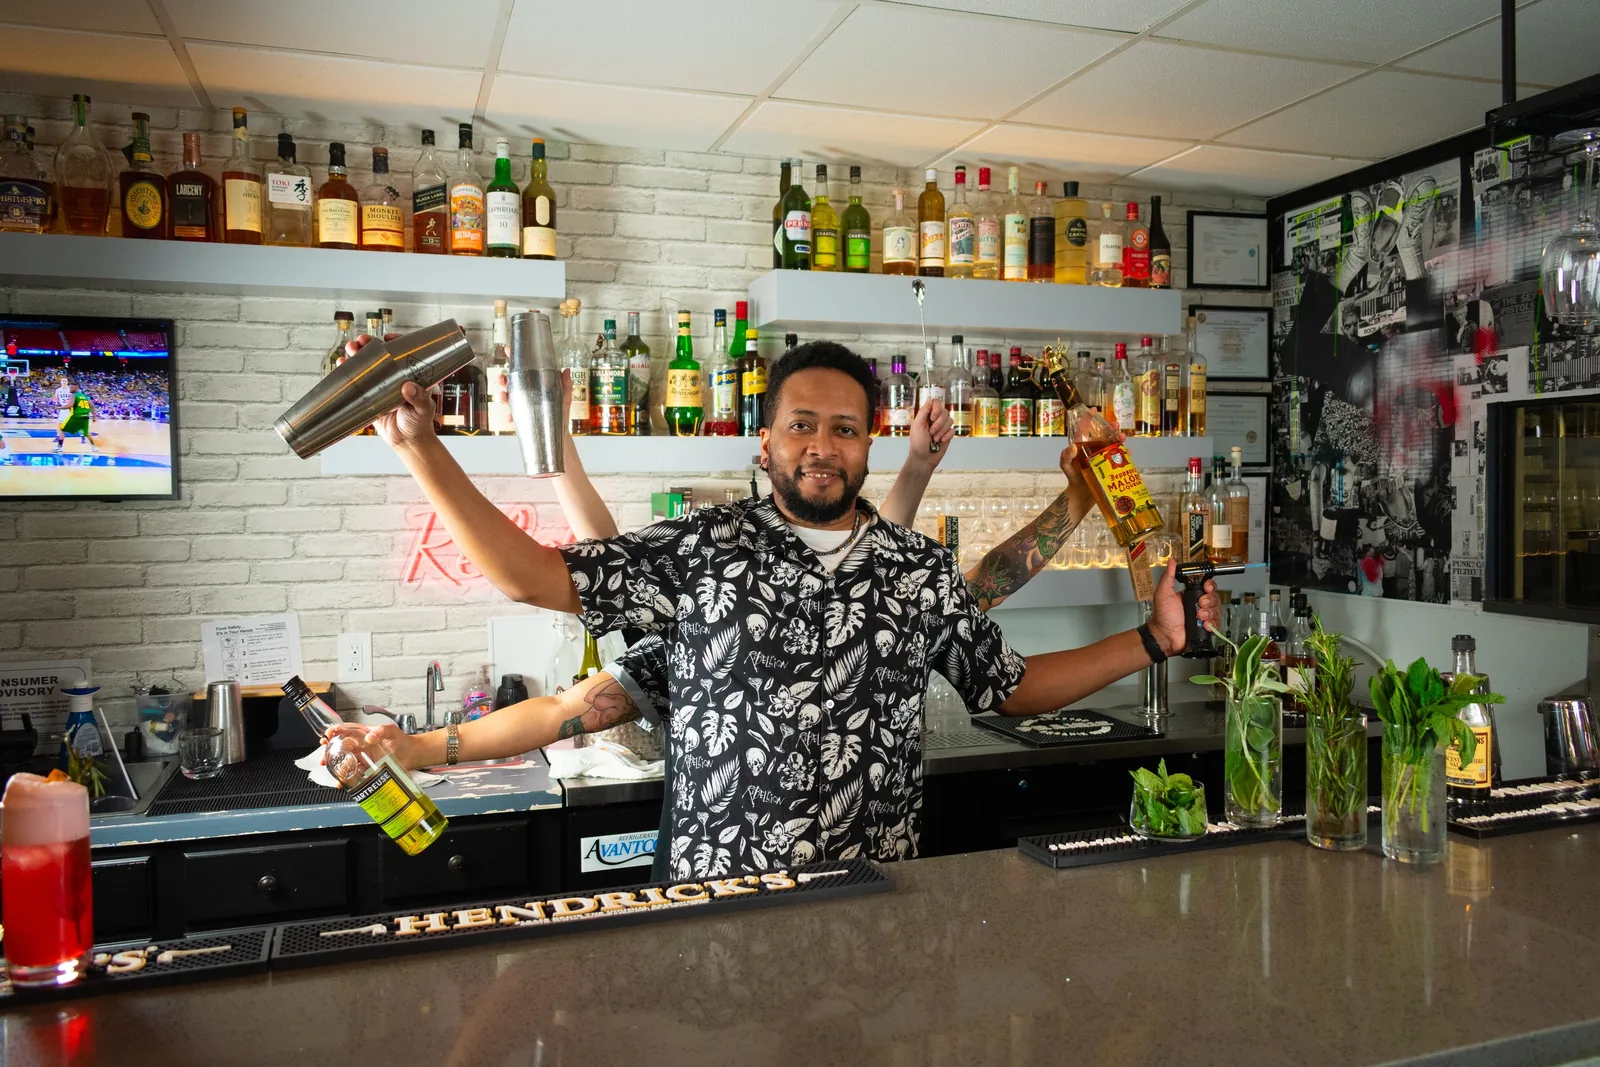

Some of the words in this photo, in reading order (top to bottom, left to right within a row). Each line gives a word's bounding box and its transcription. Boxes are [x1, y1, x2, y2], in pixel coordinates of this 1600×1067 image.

[272, 179, 291, 187] TOKI
[176, 183, 203, 196] LARCENY
[370, 207, 399, 215] MONKEY
[367, 213, 401, 222] SHOULDER
[1503, 296, 1518, 306] THE
[1501, 302, 1536, 315] PISTOLS
[618, 831, 658, 842] REFRIGERATIO
[394, 870, 796, 936] HENDRICK'S
